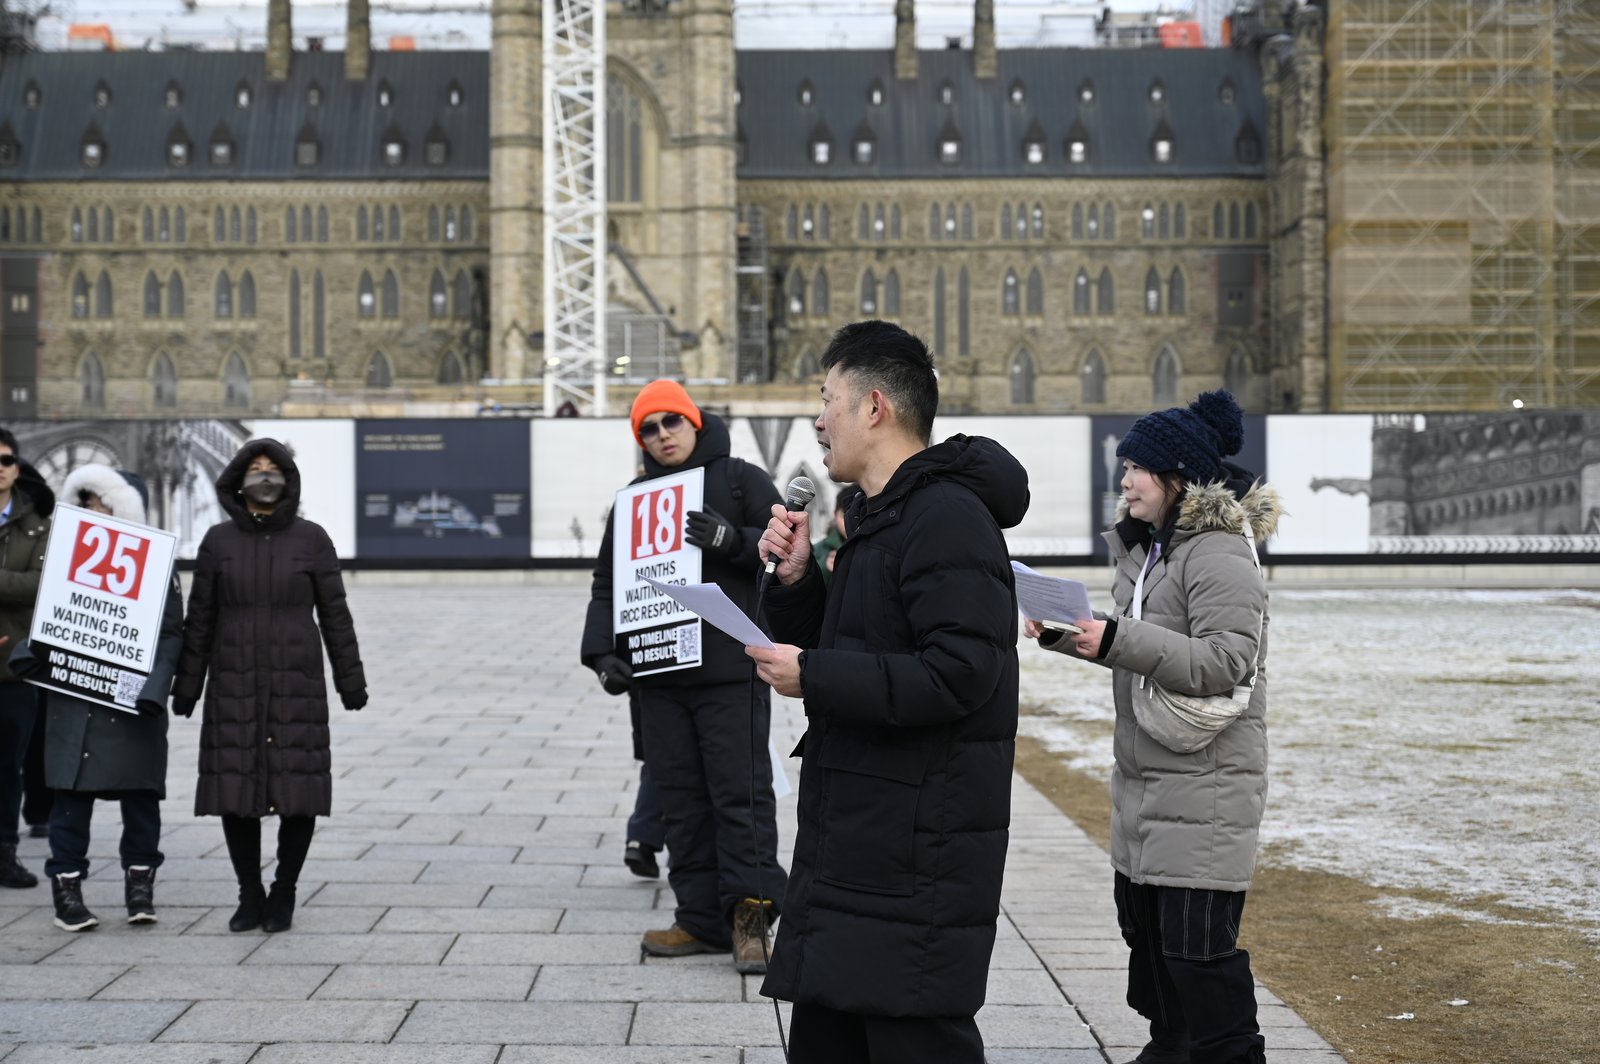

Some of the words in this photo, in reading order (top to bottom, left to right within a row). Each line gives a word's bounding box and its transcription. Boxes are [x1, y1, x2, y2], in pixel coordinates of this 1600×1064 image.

[636, 488, 677, 558] 18
[73, 525, 141, 596] 25
[635, 560, 676, 582] MONTHS
[69, 592, 128, 619] MONTHS
[620, 607, 640, 625] IRCC
[641, 600, 690, 620] RESPONS
[53, 606, 108, 634] WAITING
[112, 623, 139, 642] FOR
[40, 621, 70, 641] IRCC
[72, 631, 145, 663] RESPONSE
[628, 635, 640, 650] NO
[632, 650, 643, 665] NO
[644, 644, 678, 663] RESULTS
[49, 650, 66, 667] NO
[51, 666, 68, 683] NO
[69, 673, 117, 697] RESULTS
